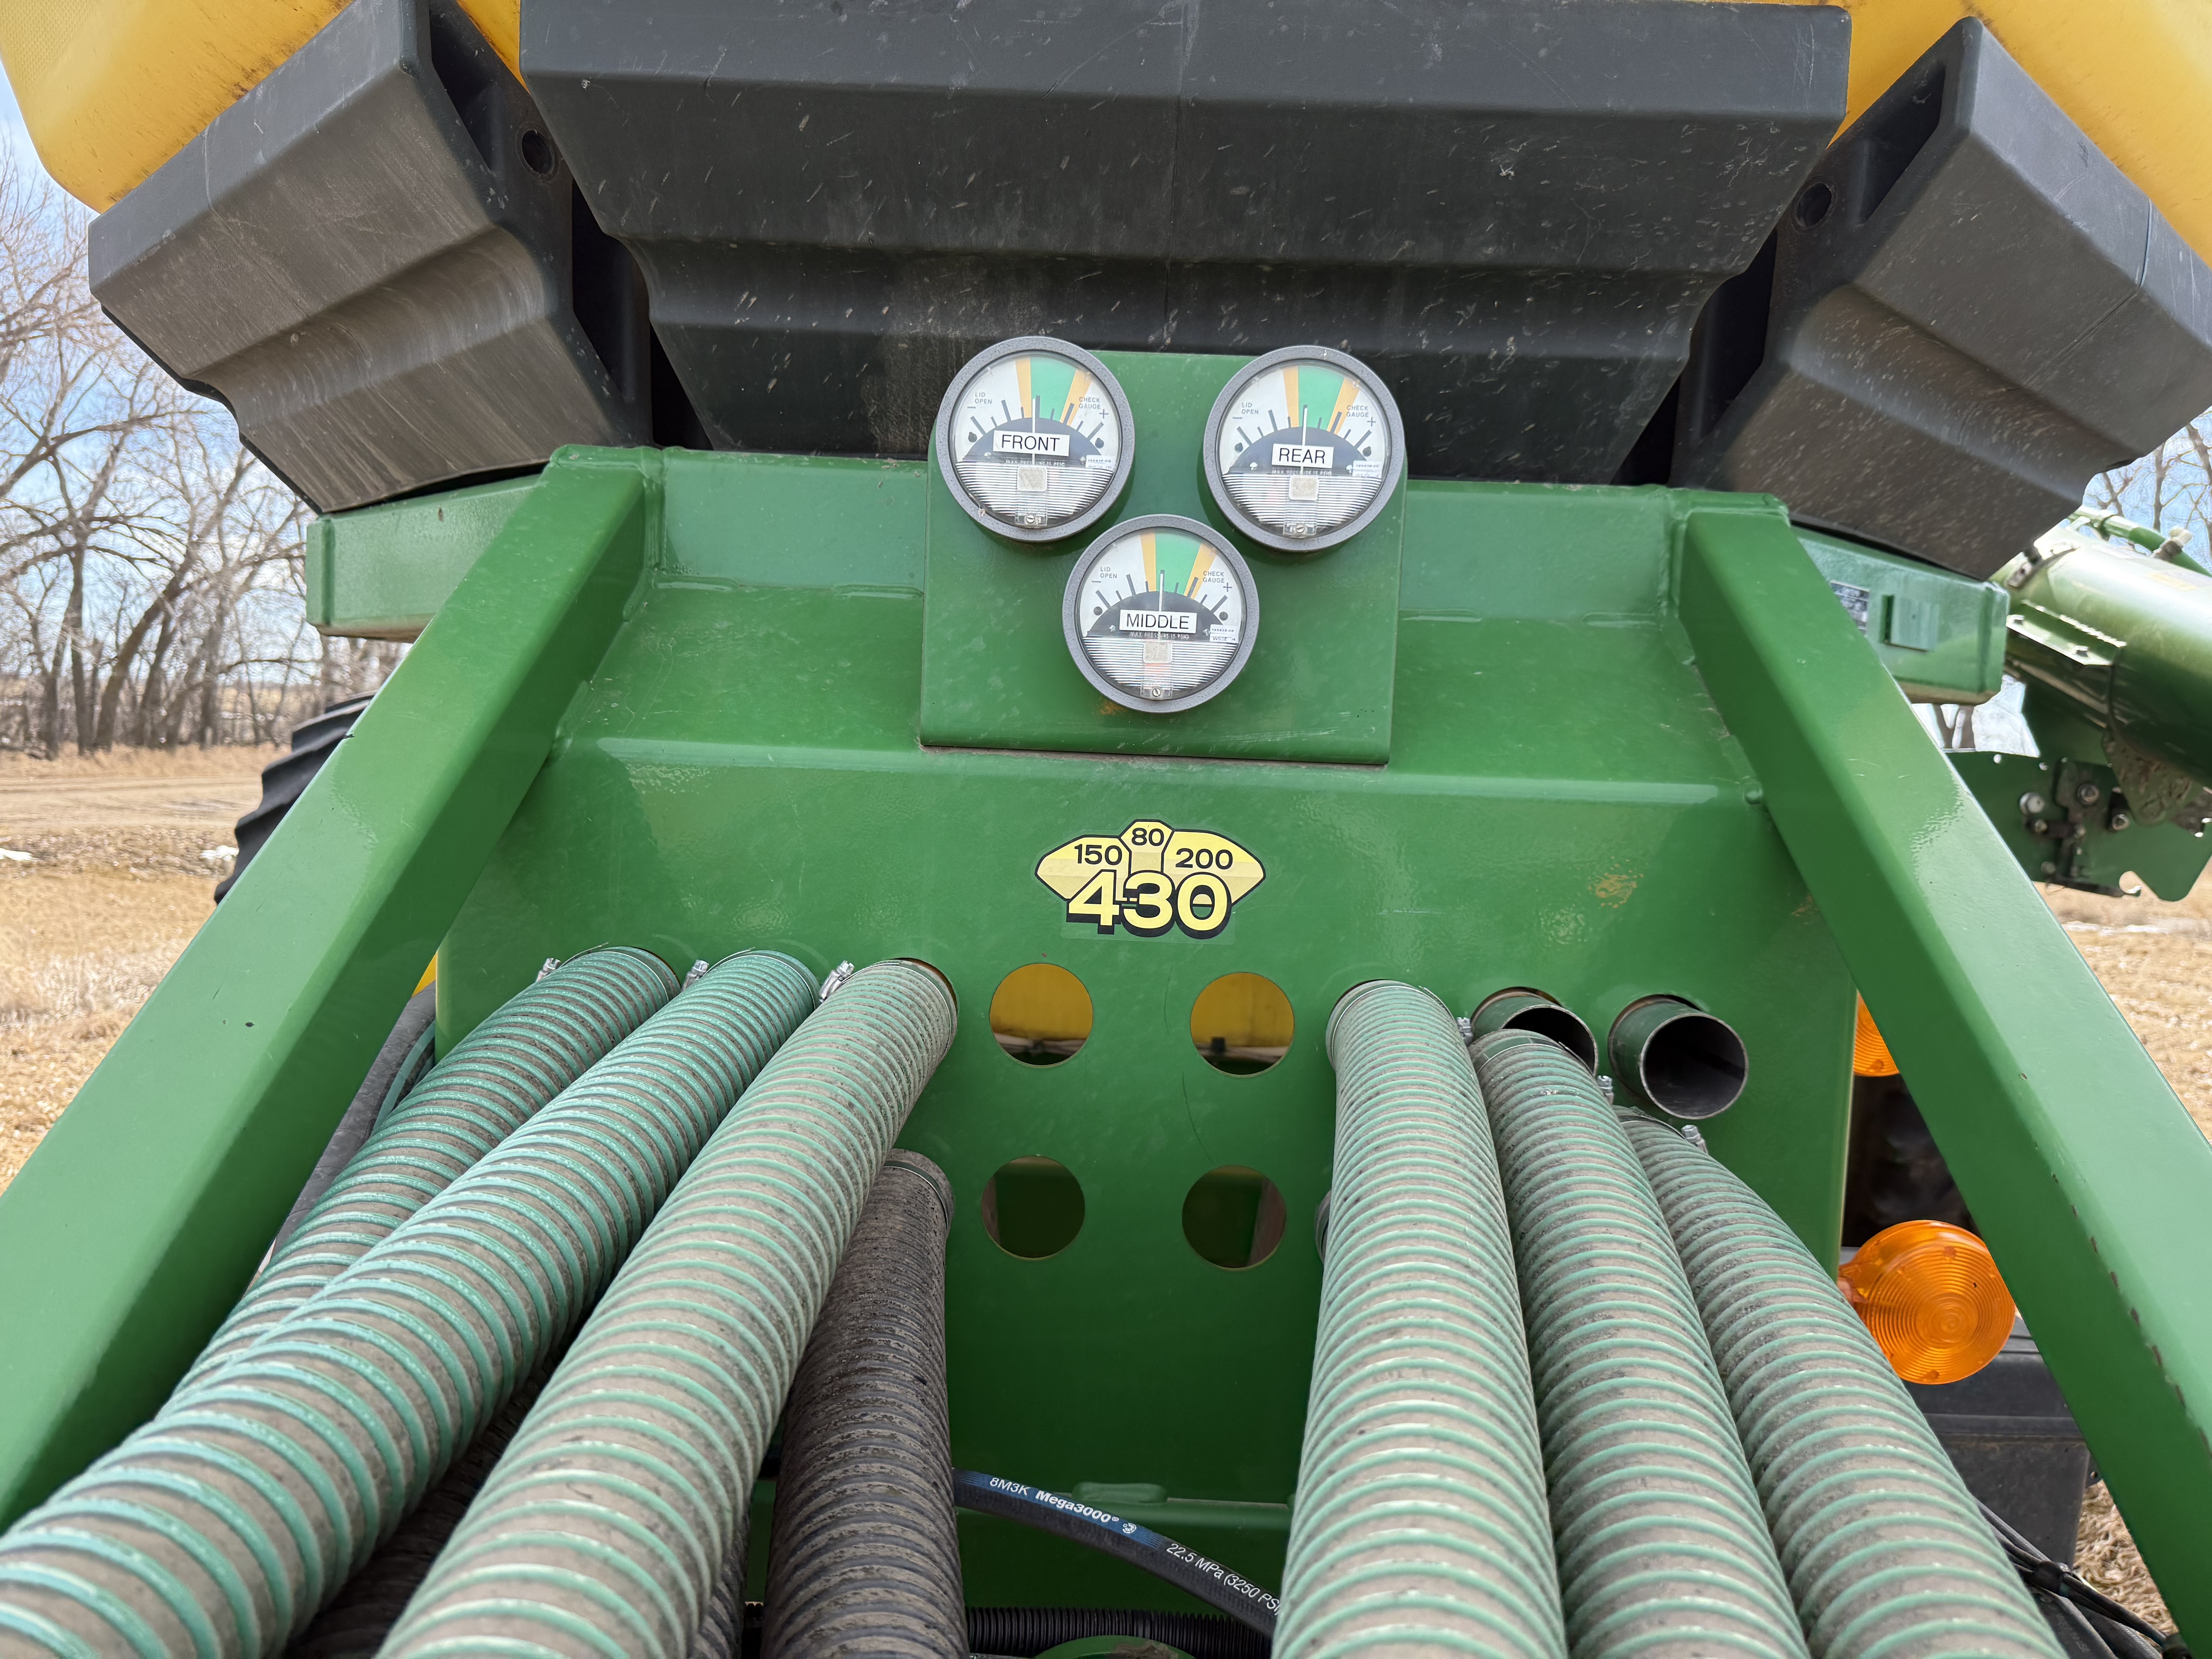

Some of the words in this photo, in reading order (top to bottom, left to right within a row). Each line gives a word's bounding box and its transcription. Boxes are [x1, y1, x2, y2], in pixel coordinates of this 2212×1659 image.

[1001, 434, 1060, 452] FRONT
[1279, 448, 1326, 464] REAR
[1126, 613, 1189, 630] MIDDLE
[1131, 827, 1164, 847] 80
[1074, 843, 1123, 866] 150
[1175, 848, 1233, 870] 200
[1067, 870, 1230, 937] 430
[989, 1477, 1031, 1496] 8M3K
[1166, 1543, 1197, 1563] 22.5
[1195, 1558, 1224, 1580] MPa
[1223, 1573, 1261, 1598] (3250
